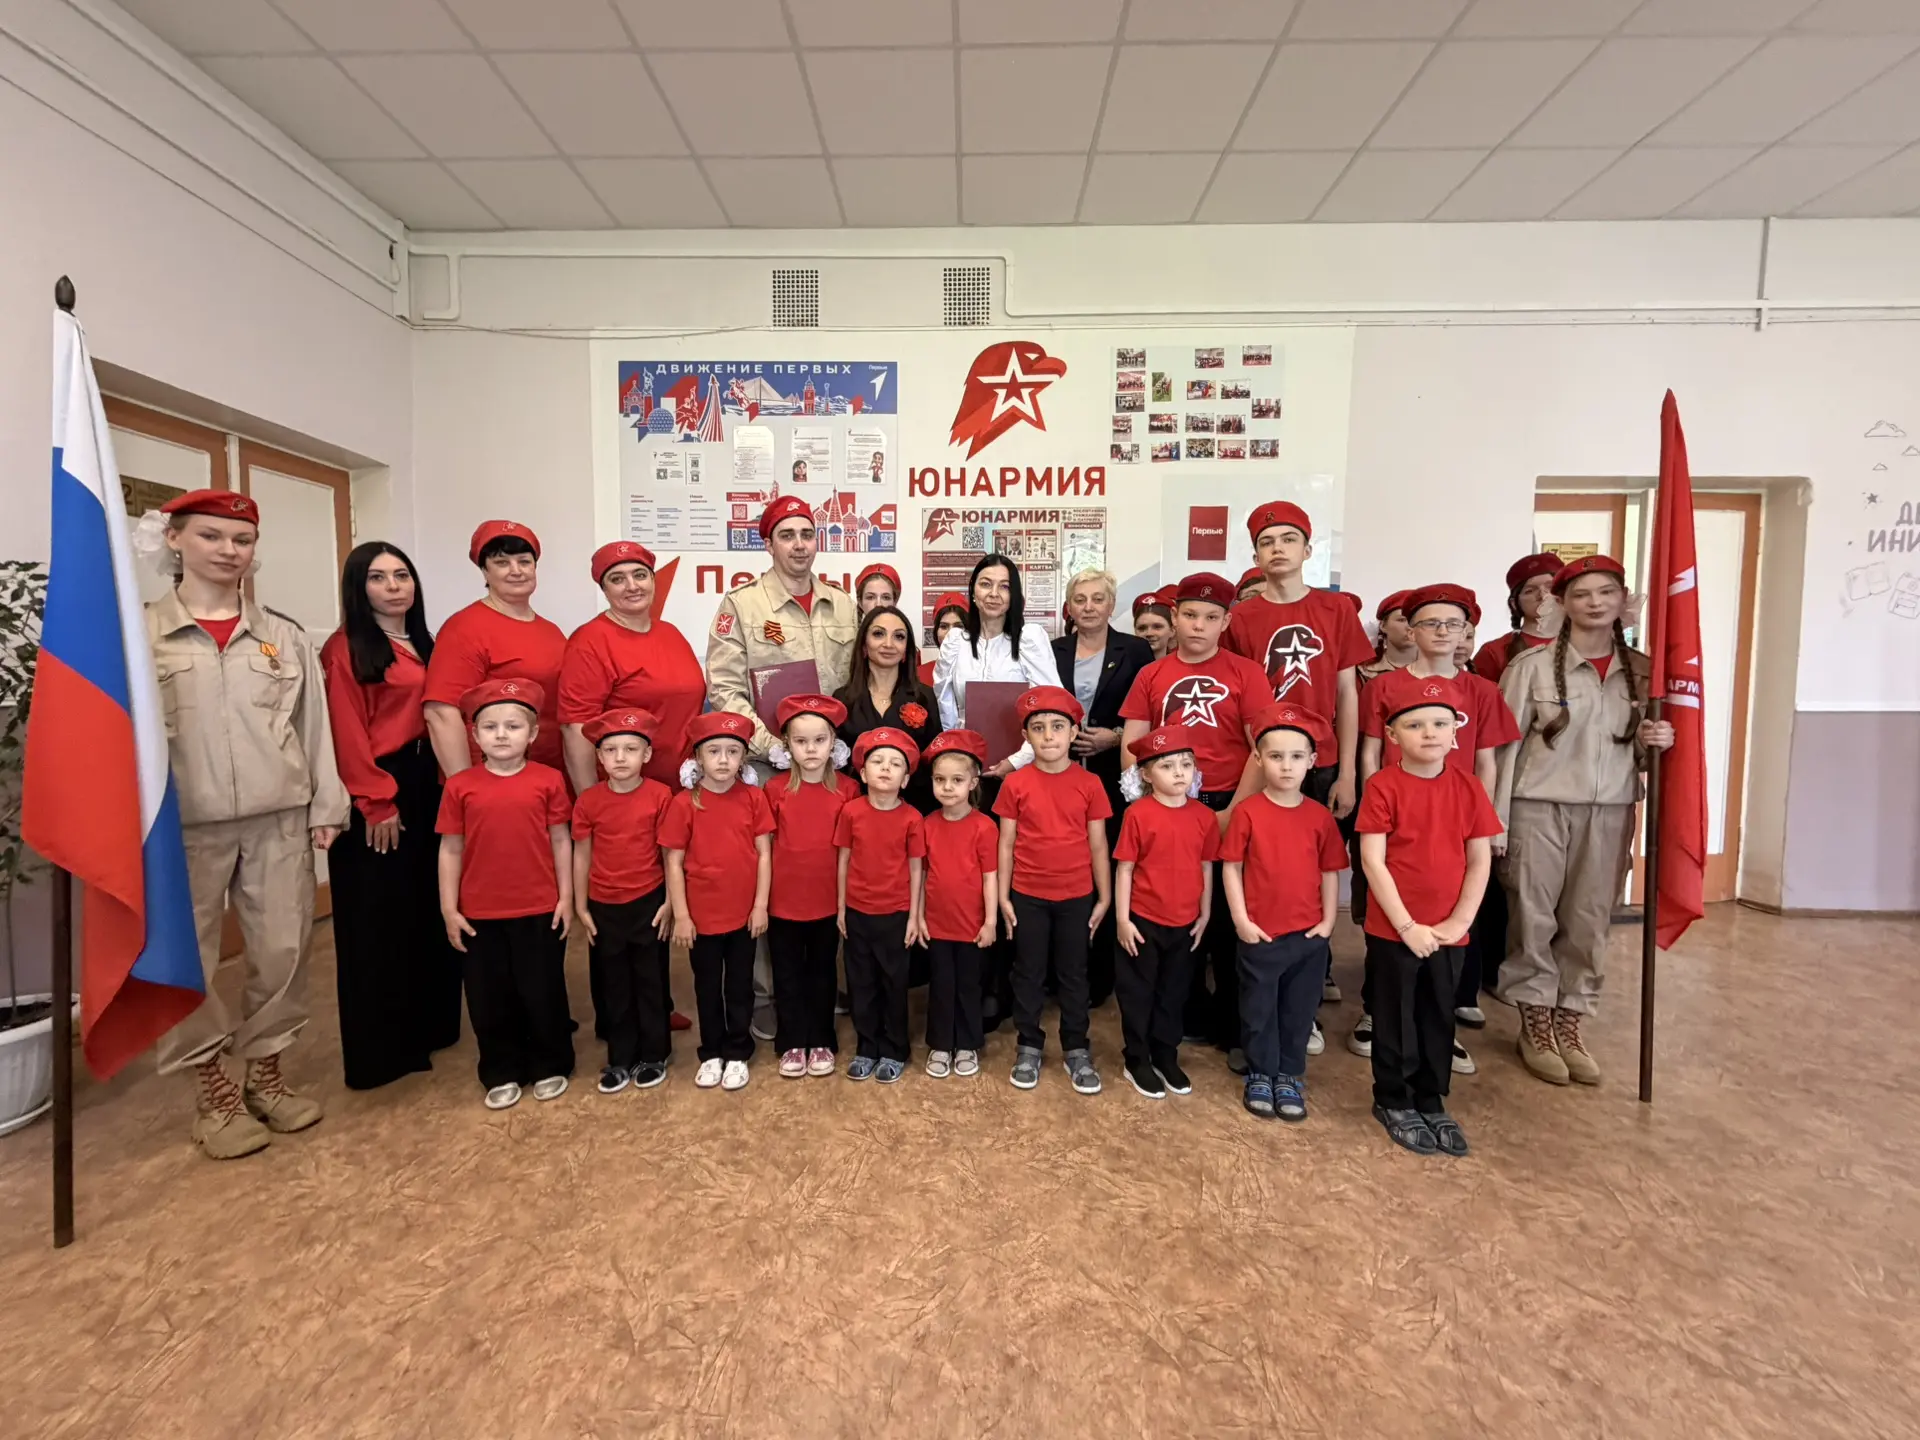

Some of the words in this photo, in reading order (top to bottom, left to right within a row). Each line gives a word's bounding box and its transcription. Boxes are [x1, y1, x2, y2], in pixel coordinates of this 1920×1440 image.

[656, 364, 764, 375] ДВИЖЕНИЕ
[773, 364, 852, 375] ПЕРВЫХ
[908, 466, 1107, 498] ЮНАРМИЯ
[961, 510, 1060, 524] ЮНАРМИЯ
[1895, 500, 1920, 526] Д
[1192, 527, 1223, 537] Первые
